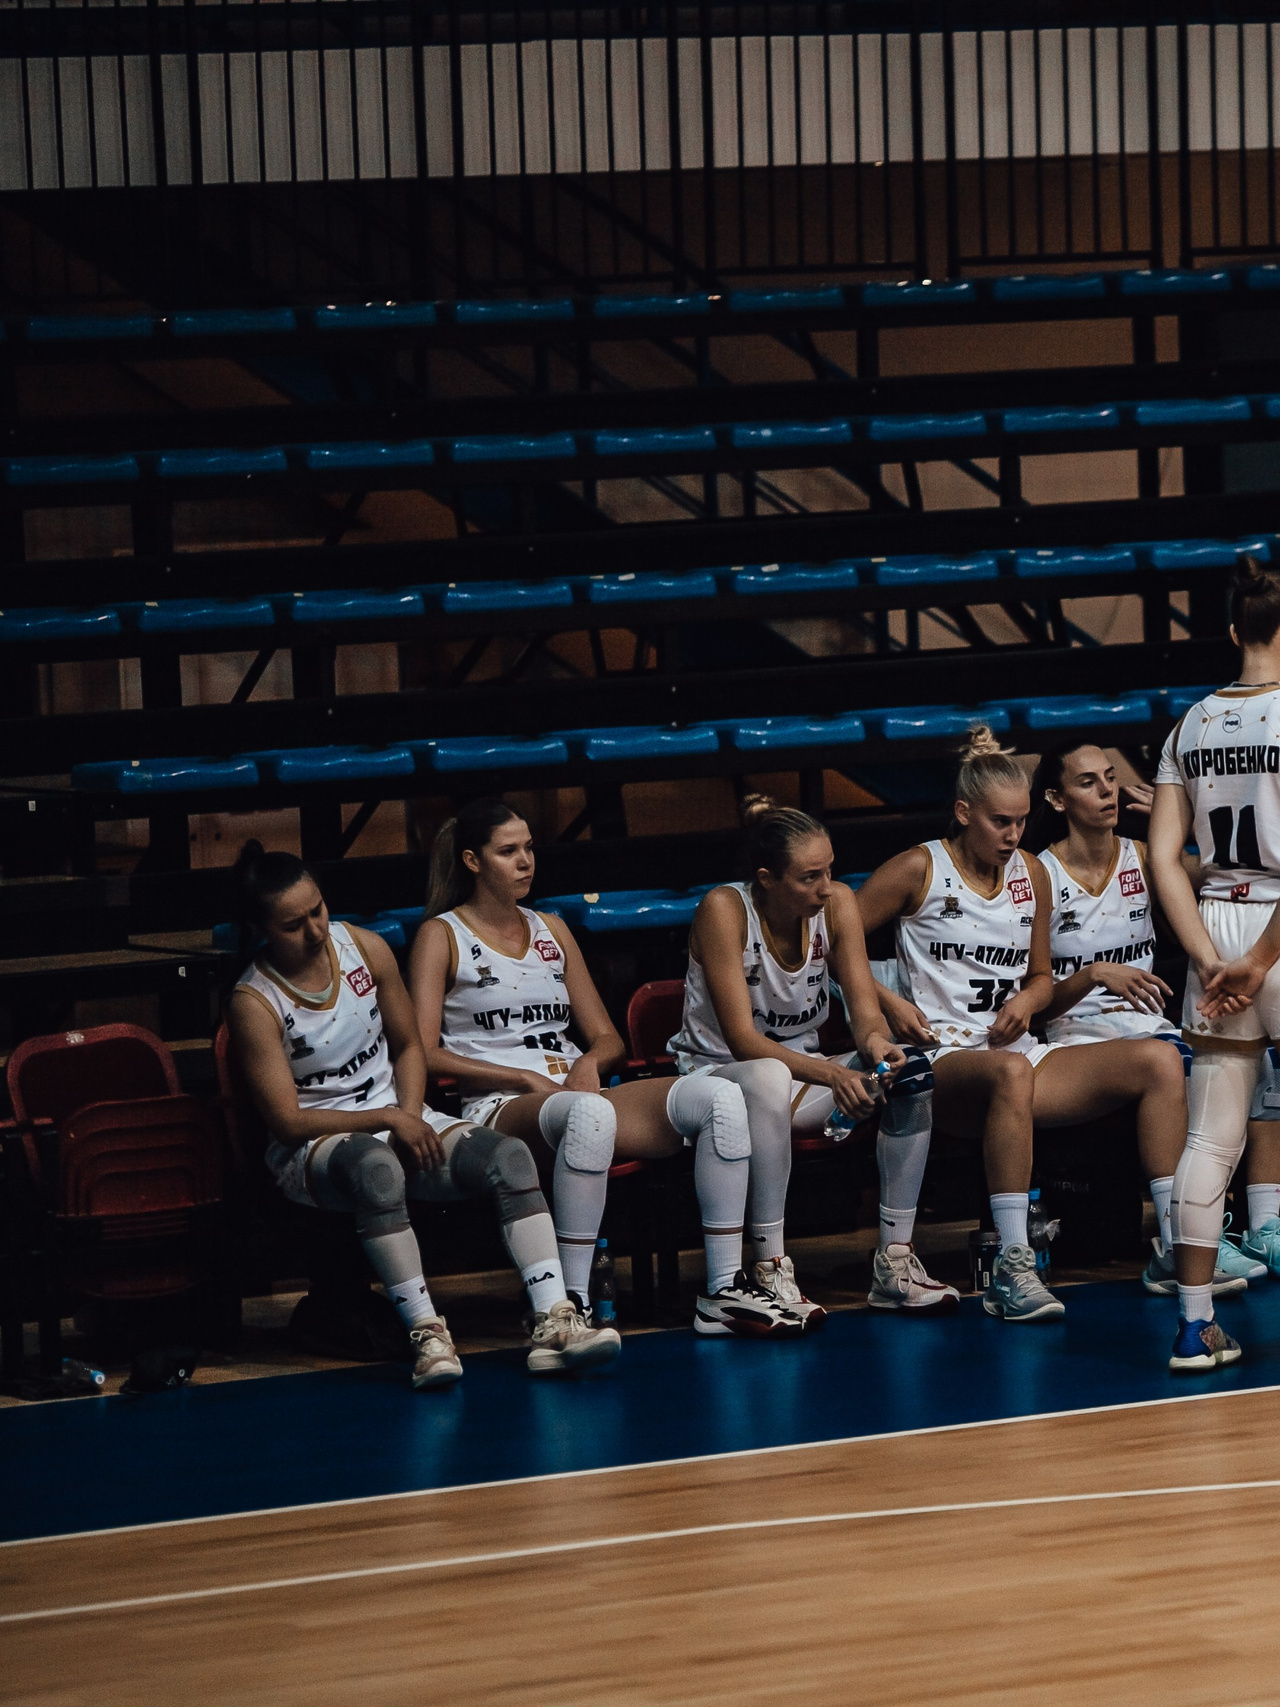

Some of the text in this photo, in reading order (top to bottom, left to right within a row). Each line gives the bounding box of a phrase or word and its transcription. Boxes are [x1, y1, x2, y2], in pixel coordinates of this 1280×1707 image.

[1183, 745, 1280, 781] КОРОБЕНКО
[1208, 804, 1266, 871] 11
[1120, 869, 1140, 885] FON
[1011, 879, 1029, 892] FON
[1122, 880, 1141, 895] BET
[1013, 888, 1032, 902] BET
[543, 949, 558, 959] BET
[355, 977, 374, 995] BET
[967, 979, 1015, 1013] 32
[352, 1076, 375, 1104] 7
[526, 1271, 555, 1286] ILA
